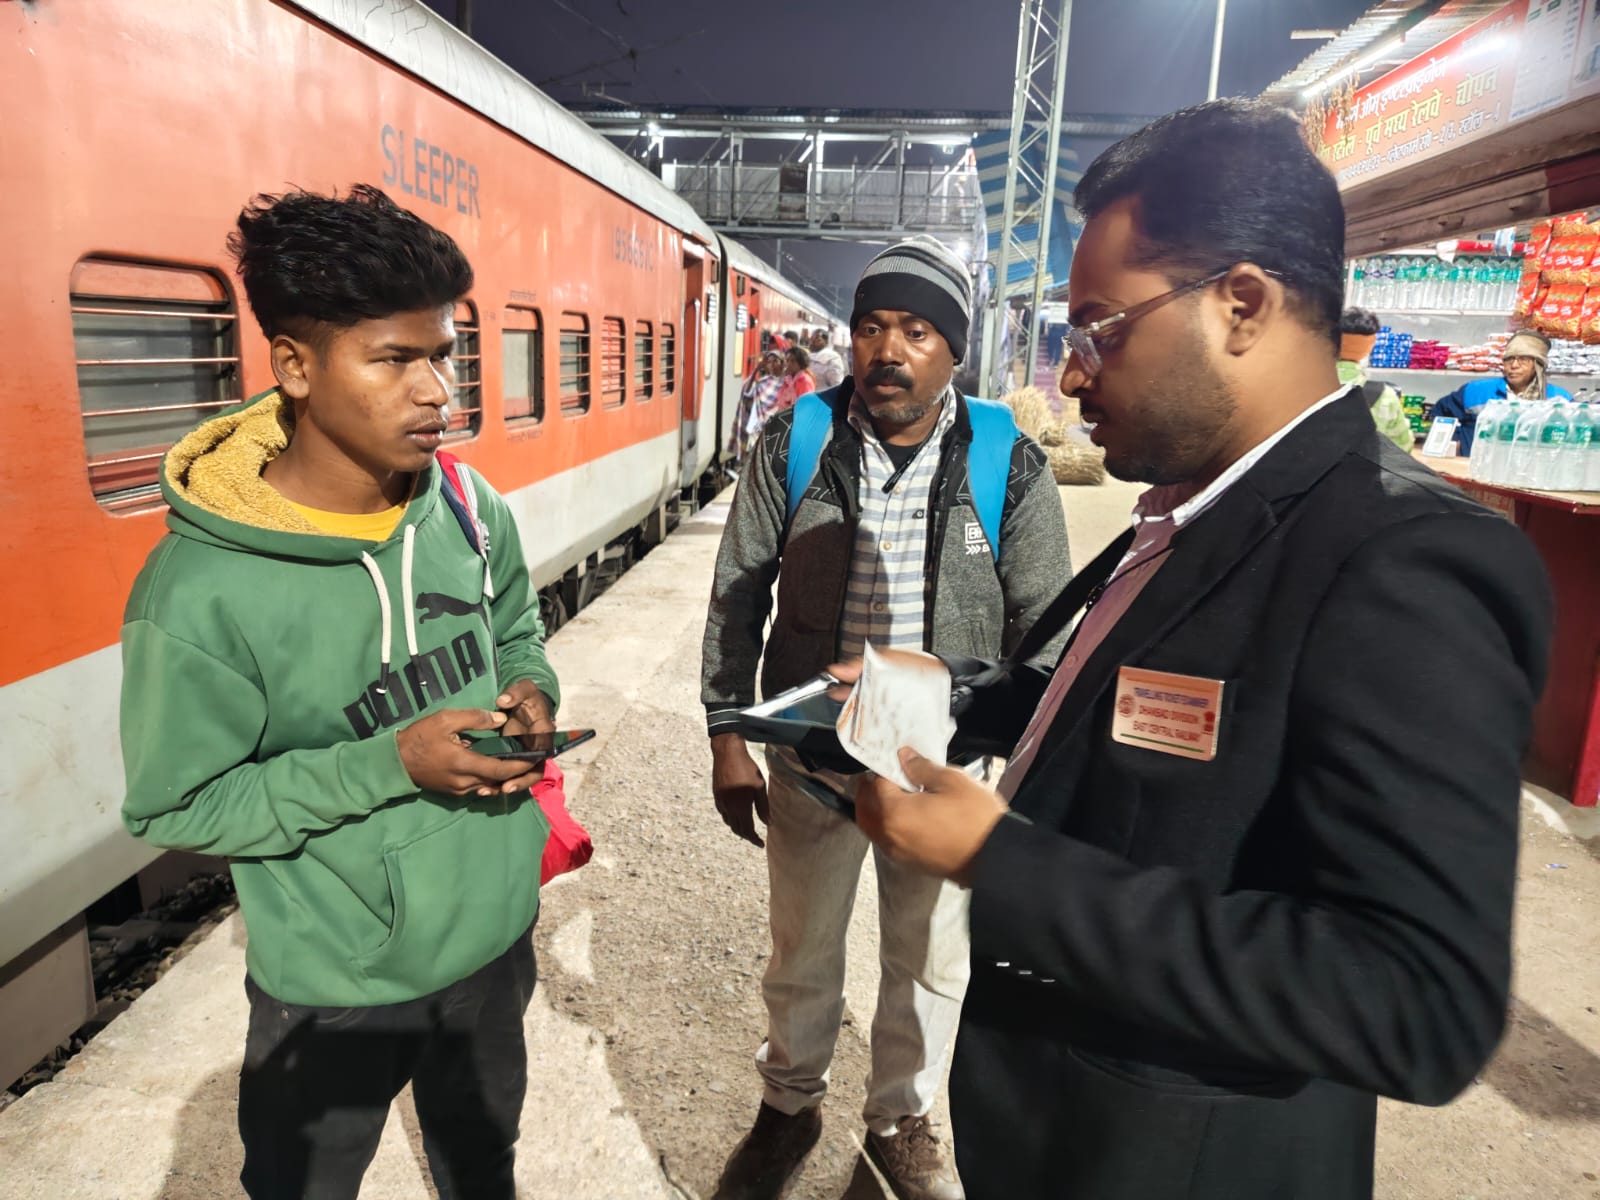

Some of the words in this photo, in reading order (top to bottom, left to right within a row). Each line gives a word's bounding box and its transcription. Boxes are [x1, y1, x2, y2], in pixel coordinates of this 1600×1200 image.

[1365, 115, 1383, 155] पूर्व
[1384, 107, 1410, 138] मध्य
[1411, 88, 1442, 128] रेलवे
[381, 123, 481, 219] SLEEPER
[342, 630, 487, 741] PUMA
